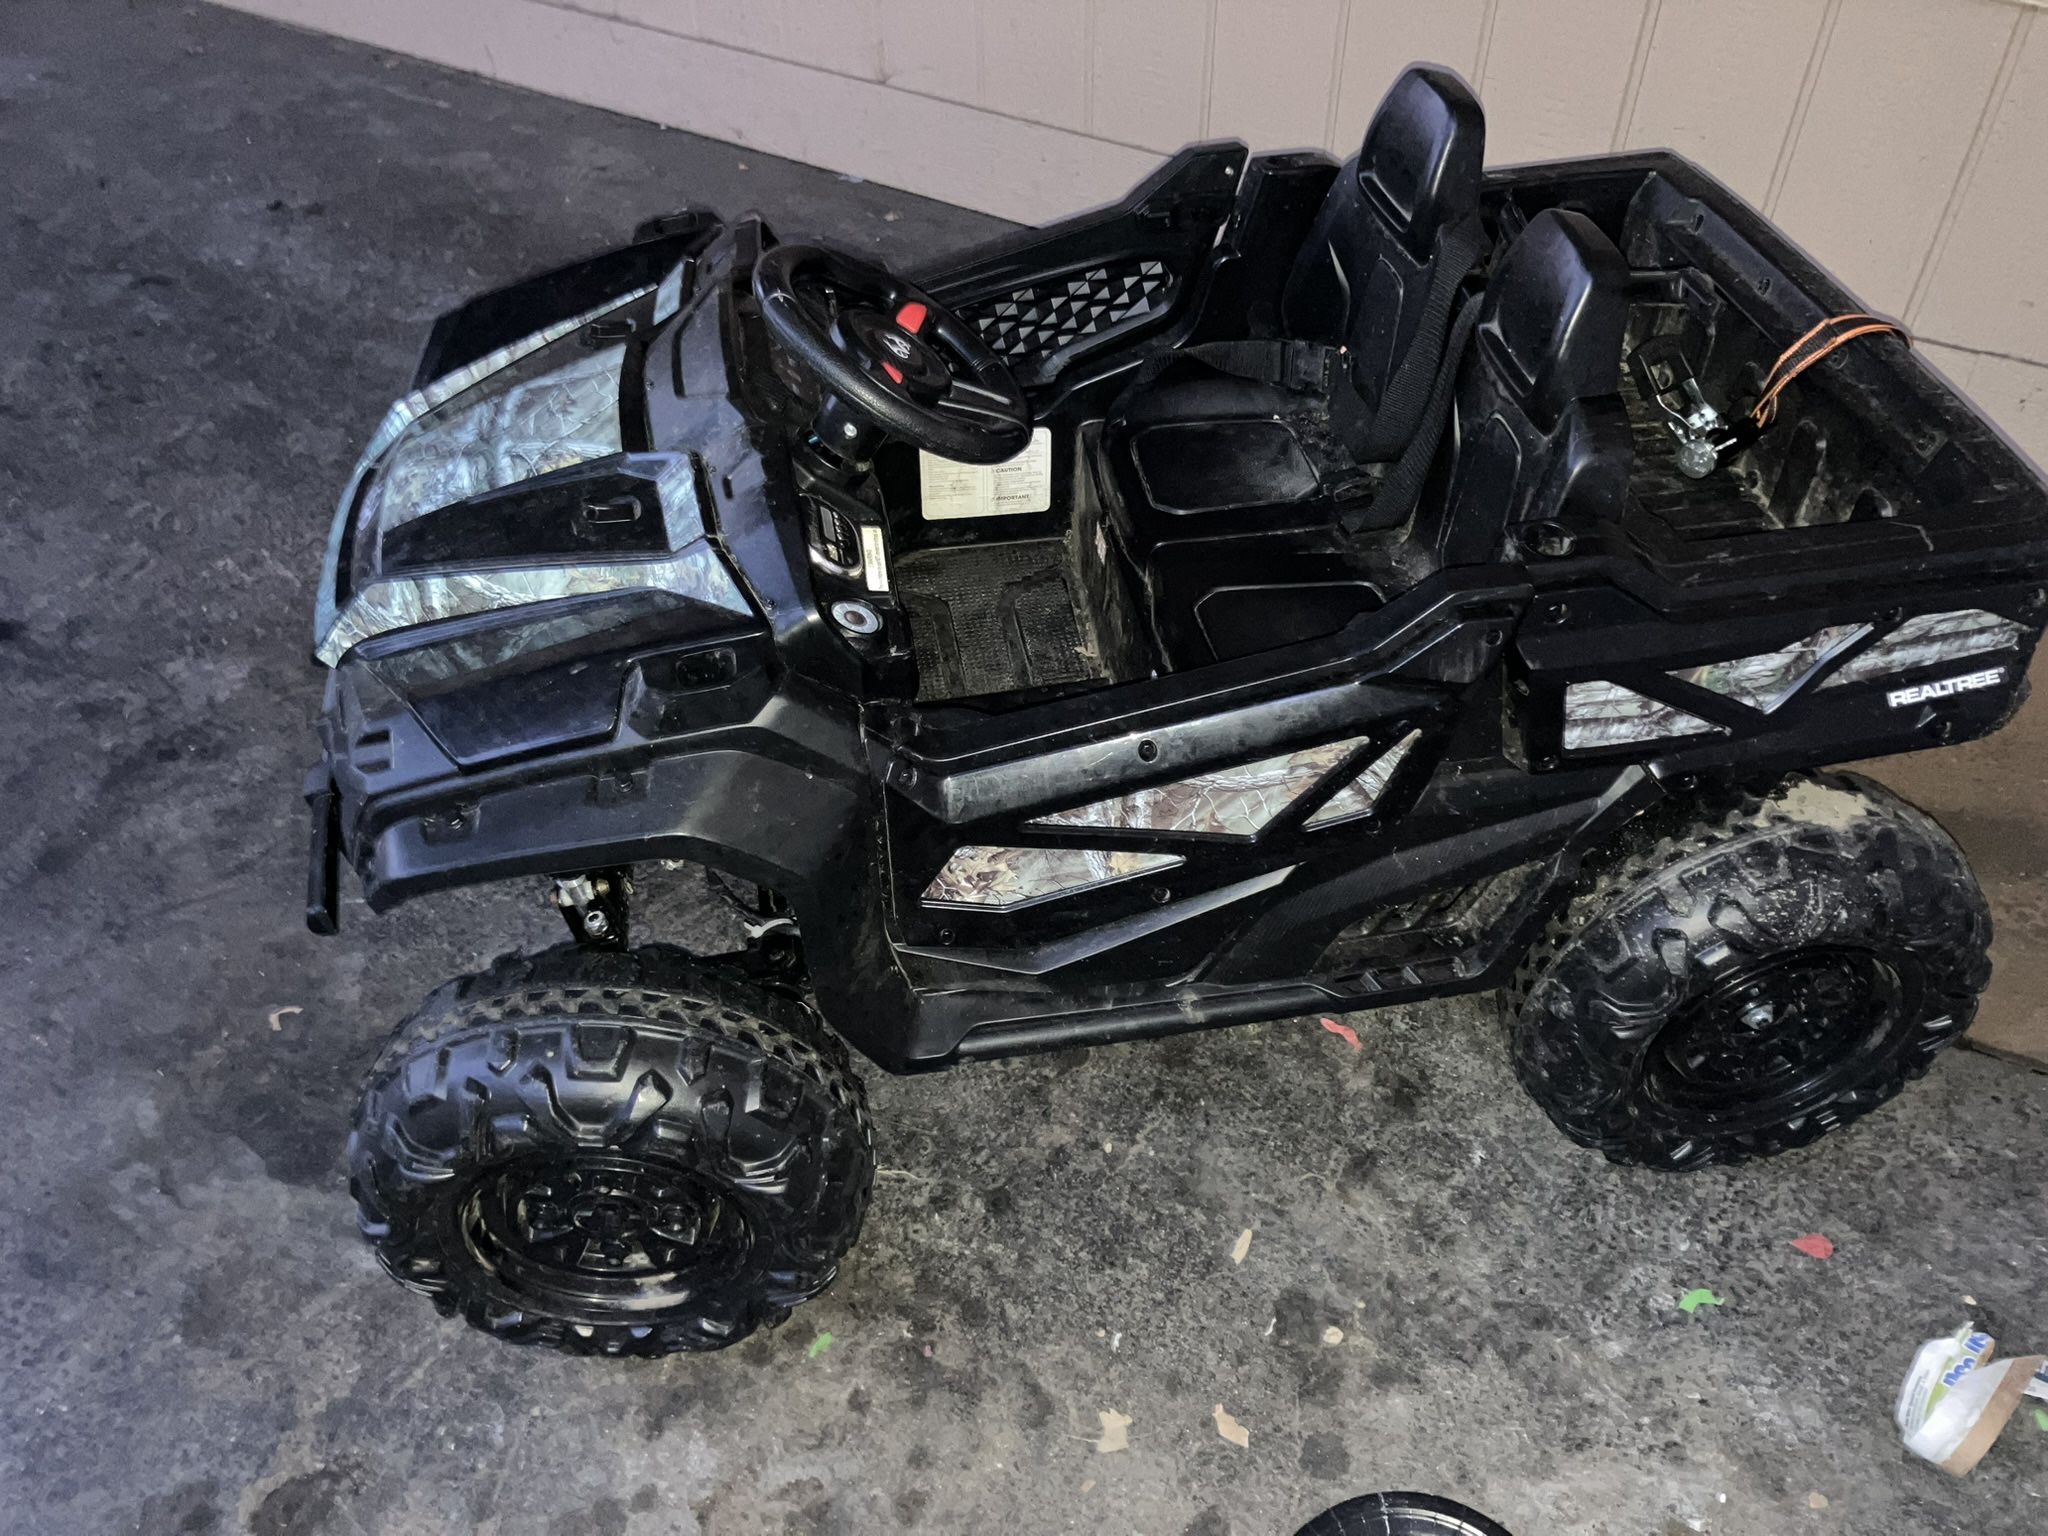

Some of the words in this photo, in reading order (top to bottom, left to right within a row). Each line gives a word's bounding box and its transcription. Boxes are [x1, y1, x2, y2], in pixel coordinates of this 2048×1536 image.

[995, 466, 1023, 474] CAUTION
[995, 493, 1030, 502] IMPORTANT
[1888, 668, 2002, 708] REALTREE
